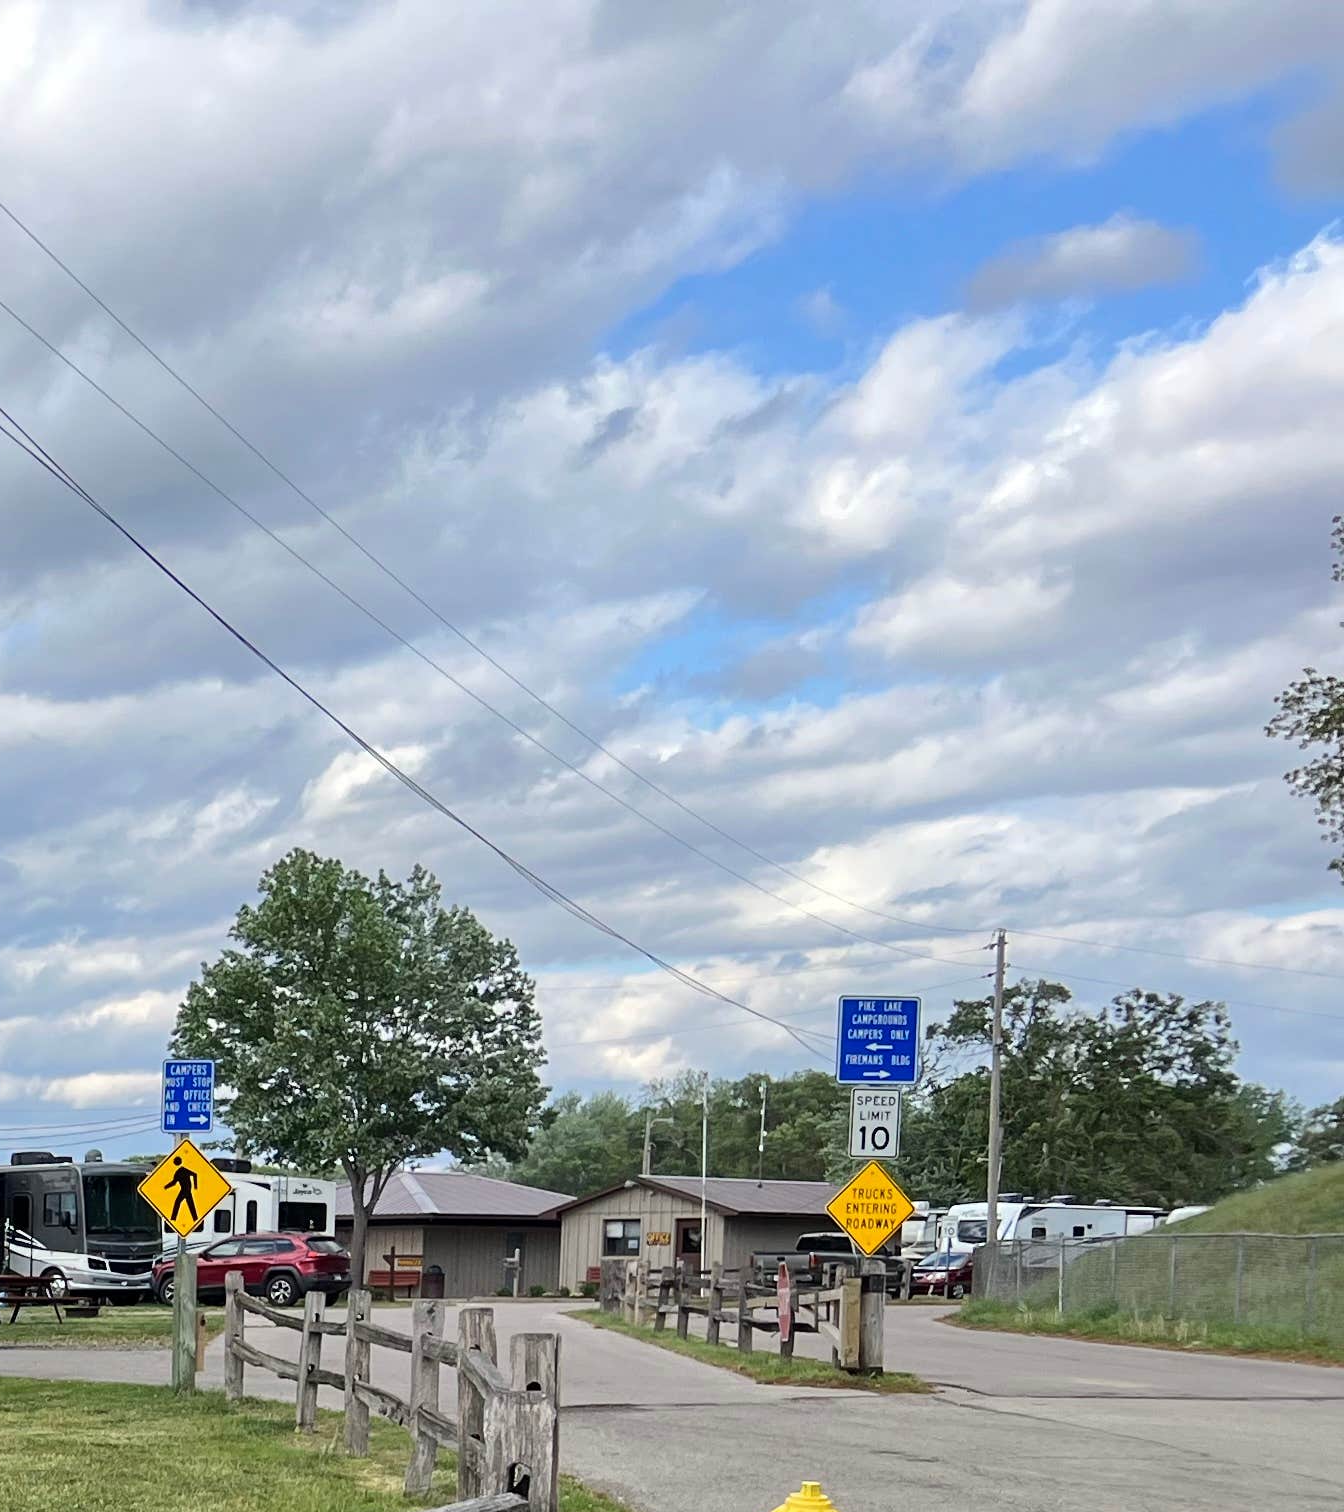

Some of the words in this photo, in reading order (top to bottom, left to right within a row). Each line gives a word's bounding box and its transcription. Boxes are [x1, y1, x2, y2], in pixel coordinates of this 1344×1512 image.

[858, 1001, 876, 1011] PIKE
[884, 1001, 903, 1012] LAKE
[852, 1014, 908, 1025] CAMPGROUNDS
[848, 1029, 883, 1040] CAMPERS
[890, 1029, 910, 1040] ONLY
[845, 1054, 883, 1065] FIREMANS
[891, 1055, 910, 1065] BLDG
[170, 1065, 207, 1075] CAMPERS
[165, 1077, 185, 1087] MUST
[192, 1077, 211, 1087] STOP
[166, 1090, 175, 1100] AT
[183, 1090, 210, 1100] OFFICE
[857, 1096, 896, 1106] SPEED
[165, 1102, 180, 1112] AND
[188, 1102, 211, 1112] CHECK
[166, 1114, 175, 1124] IN
[859, 1111, 891, 1121] LIMIT
[859, 1126, 890, 1150] 10
[852, 1188, 893, 1200] TRUCKS
[846, 1203, 896, 1214] ENTERING
[846, 1218, 896, 1230] ROADWAY
